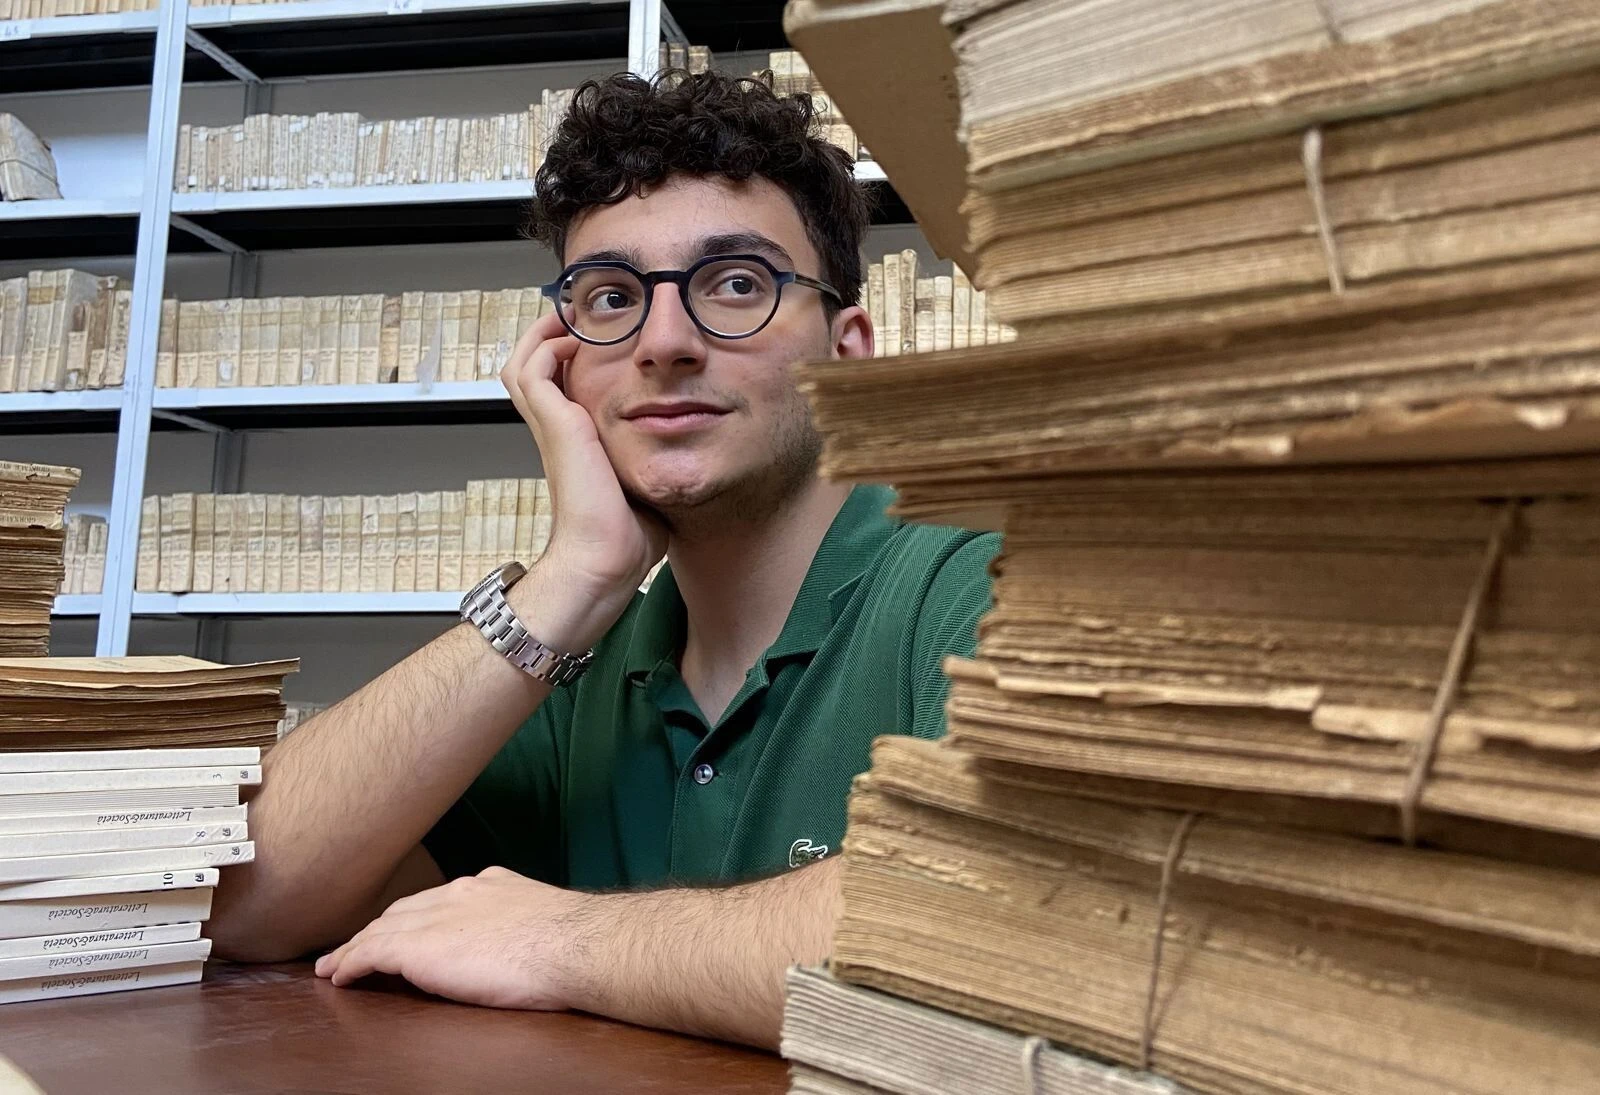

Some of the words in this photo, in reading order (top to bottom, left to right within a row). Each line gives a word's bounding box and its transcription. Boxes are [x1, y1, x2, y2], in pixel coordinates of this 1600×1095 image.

[97, 811, 192, 825] Letteratura&Società
[196, 830, 207, 838] 8
[163, 872, 174, 886] 10
[48, 902, 148, 920] Letteratura&Società
[43, 930, 145, 950] Letteratura&Società
[49, 949, 149, 968] Letteratura&Società
[41, 971, 140, 990] Letteratura&Società
